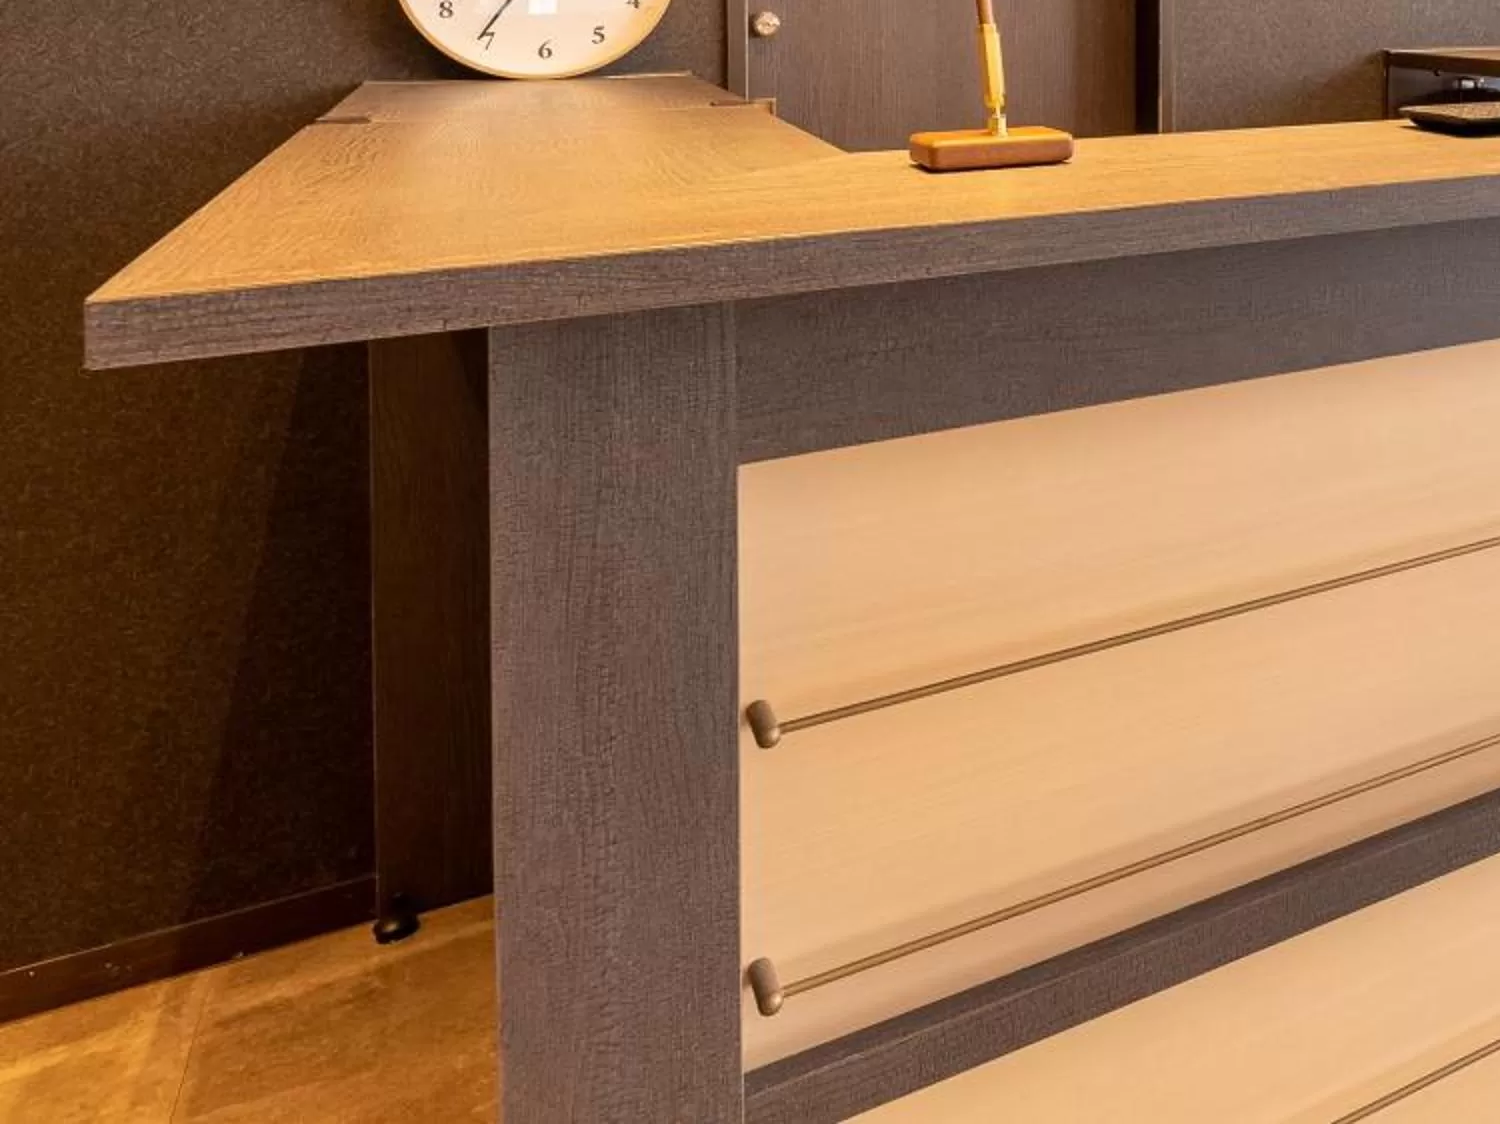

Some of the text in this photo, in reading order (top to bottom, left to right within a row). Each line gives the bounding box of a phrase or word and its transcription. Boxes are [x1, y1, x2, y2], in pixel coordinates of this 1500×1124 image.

[438, 0, 454, 18] 8
[483, 31, 495, 50] 7
[591, 26, 605, 44] 5
[537, 40, 552, 59] 6
